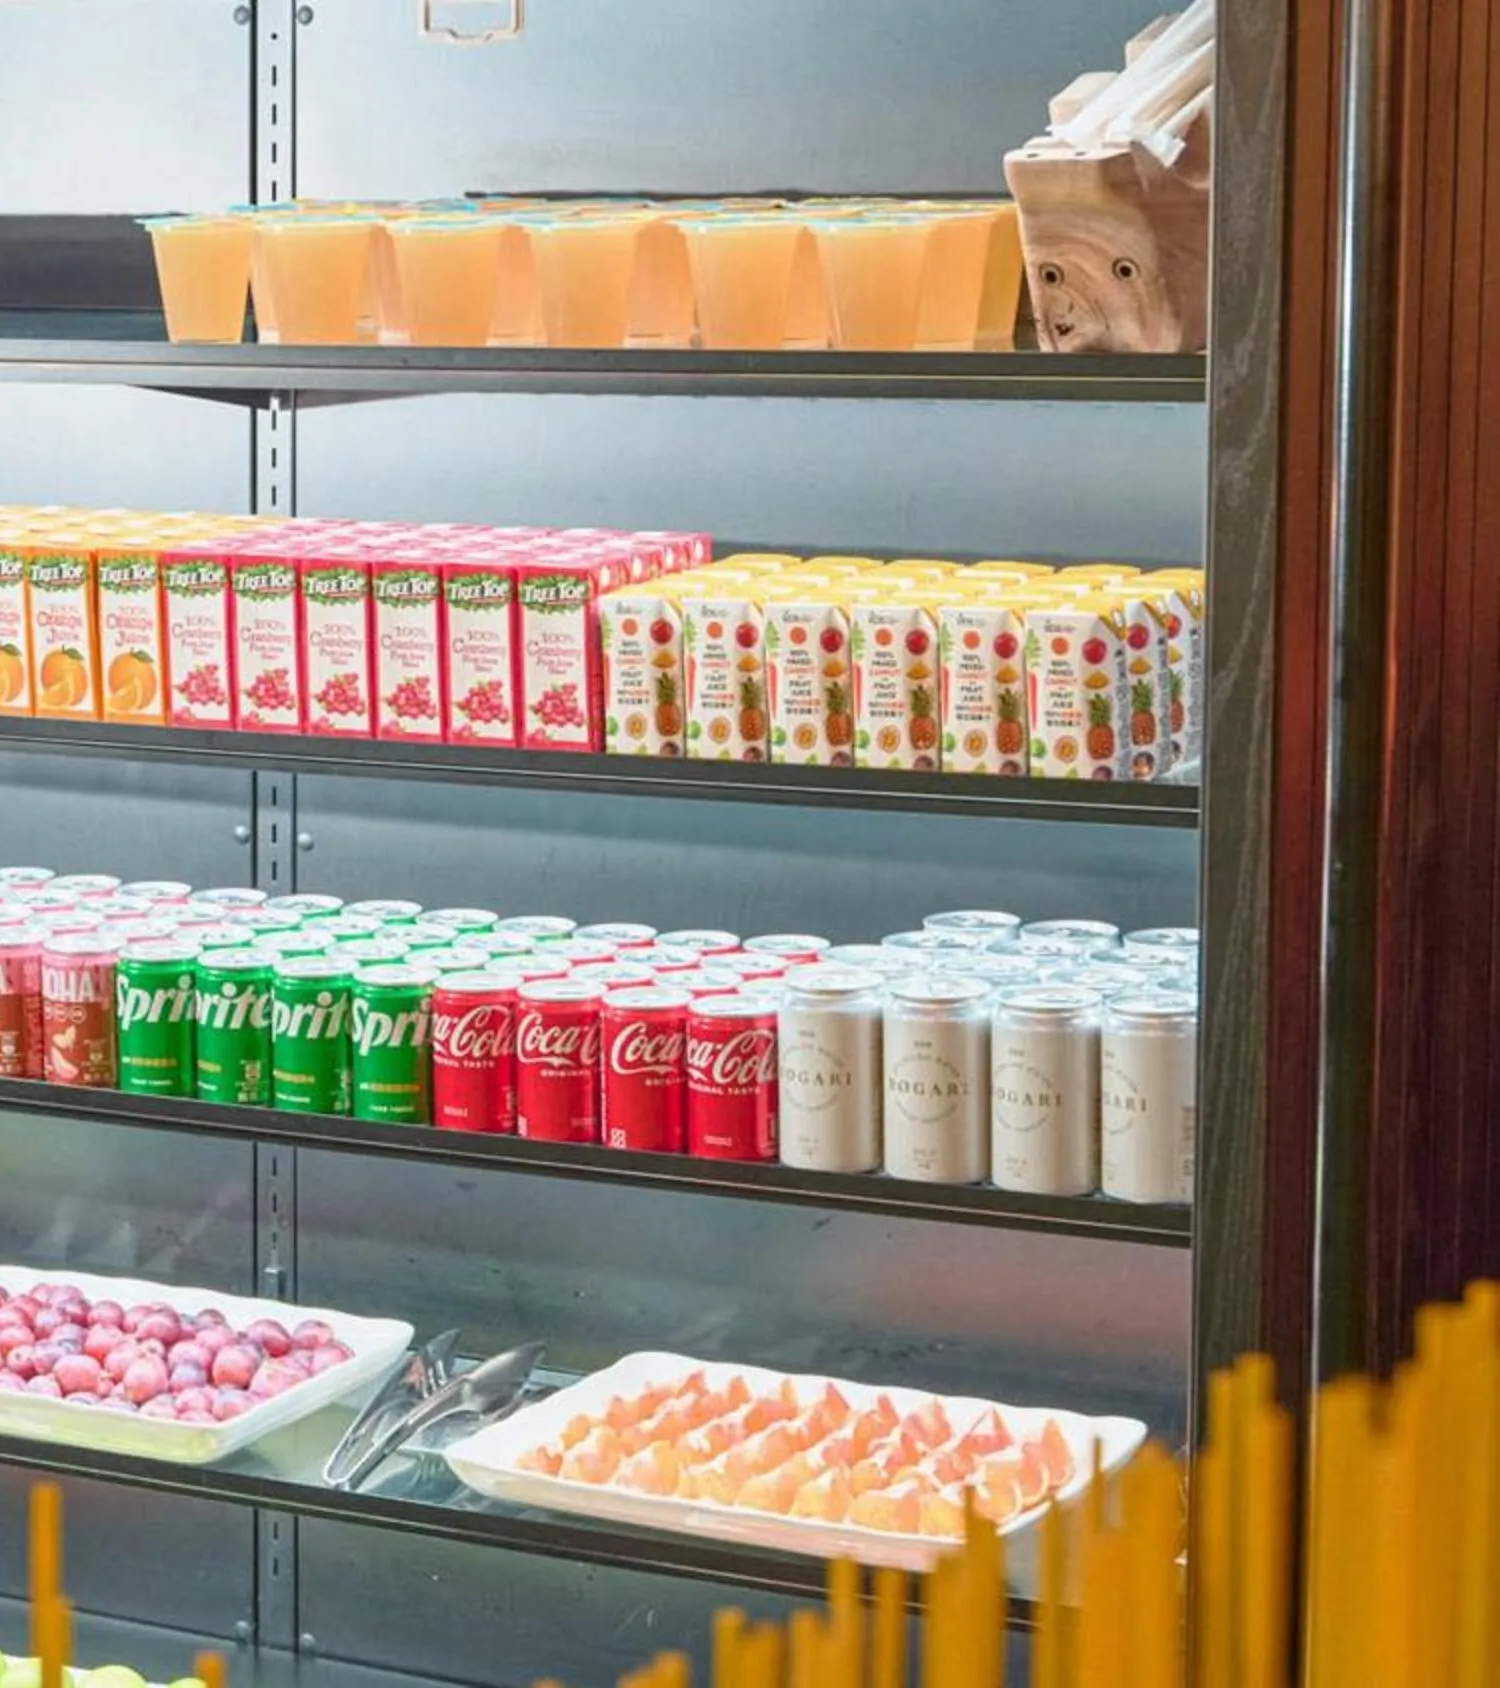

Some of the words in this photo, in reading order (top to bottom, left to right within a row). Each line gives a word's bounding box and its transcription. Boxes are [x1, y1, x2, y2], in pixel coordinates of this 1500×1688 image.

[378, 580, 408, 597] TREE
[452, 583, 483, 599] TREE
[483, 581, 508, 597] TOP
[526, 586, 556, 602] TREE
[557, 583, 584, 599] TOP
[351, 994, 432, 1057] Spri
[785, 1066, 852, 1087] OGARI
[996, 1086, 1065, 1108] OGARI
